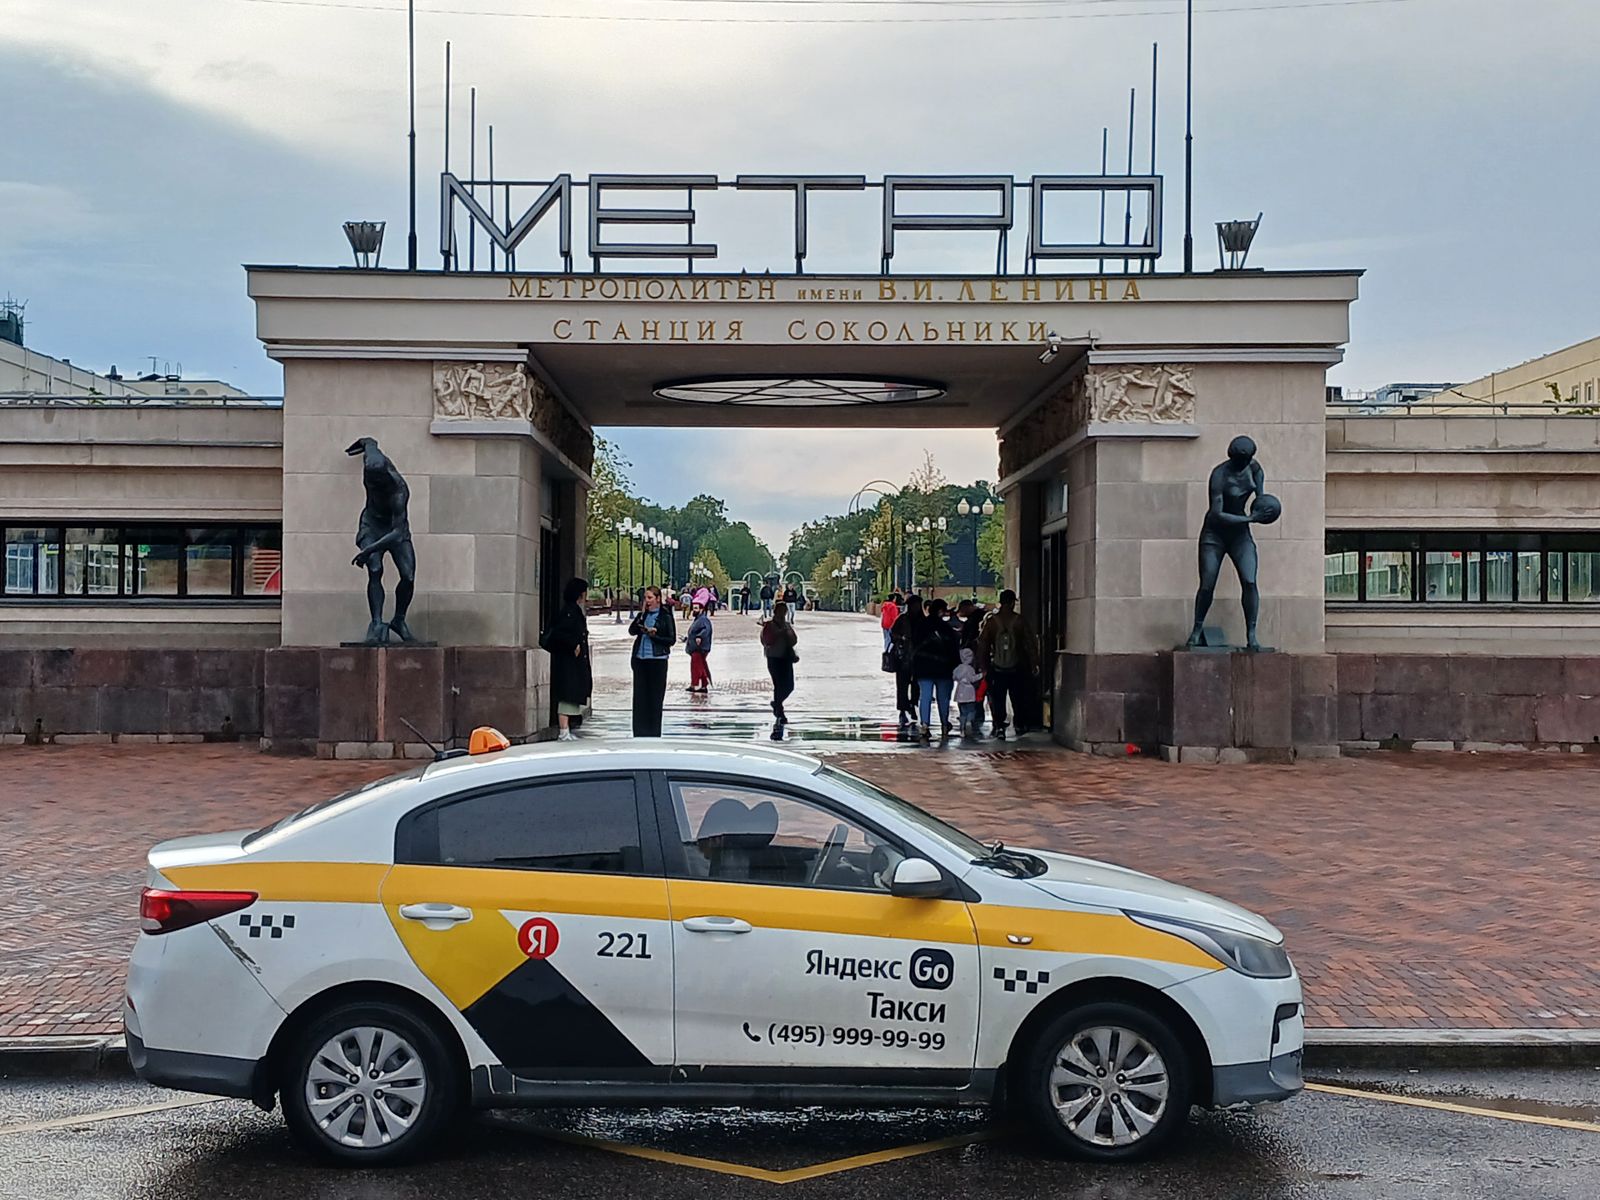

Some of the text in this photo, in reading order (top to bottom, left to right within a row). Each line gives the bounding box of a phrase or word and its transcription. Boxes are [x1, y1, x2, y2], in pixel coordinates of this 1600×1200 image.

[440, 173, 1163, 259] МЕТРО
[508, 279, 776, 300] МЕТРОПОЛИТЕН
[957, 280, 1142, 301] ЛЕНИНА
[553, 320, 1049, 342] СТАНЦИЯ СОКОЛЬНИКИ
[597, 932, 651, 959] 221
[805, 950, 949, 983] Яндекс Go
[867, 992, 946, 1023] Такси
[768, 1023, 946, 1050] (495) 999-99-99
